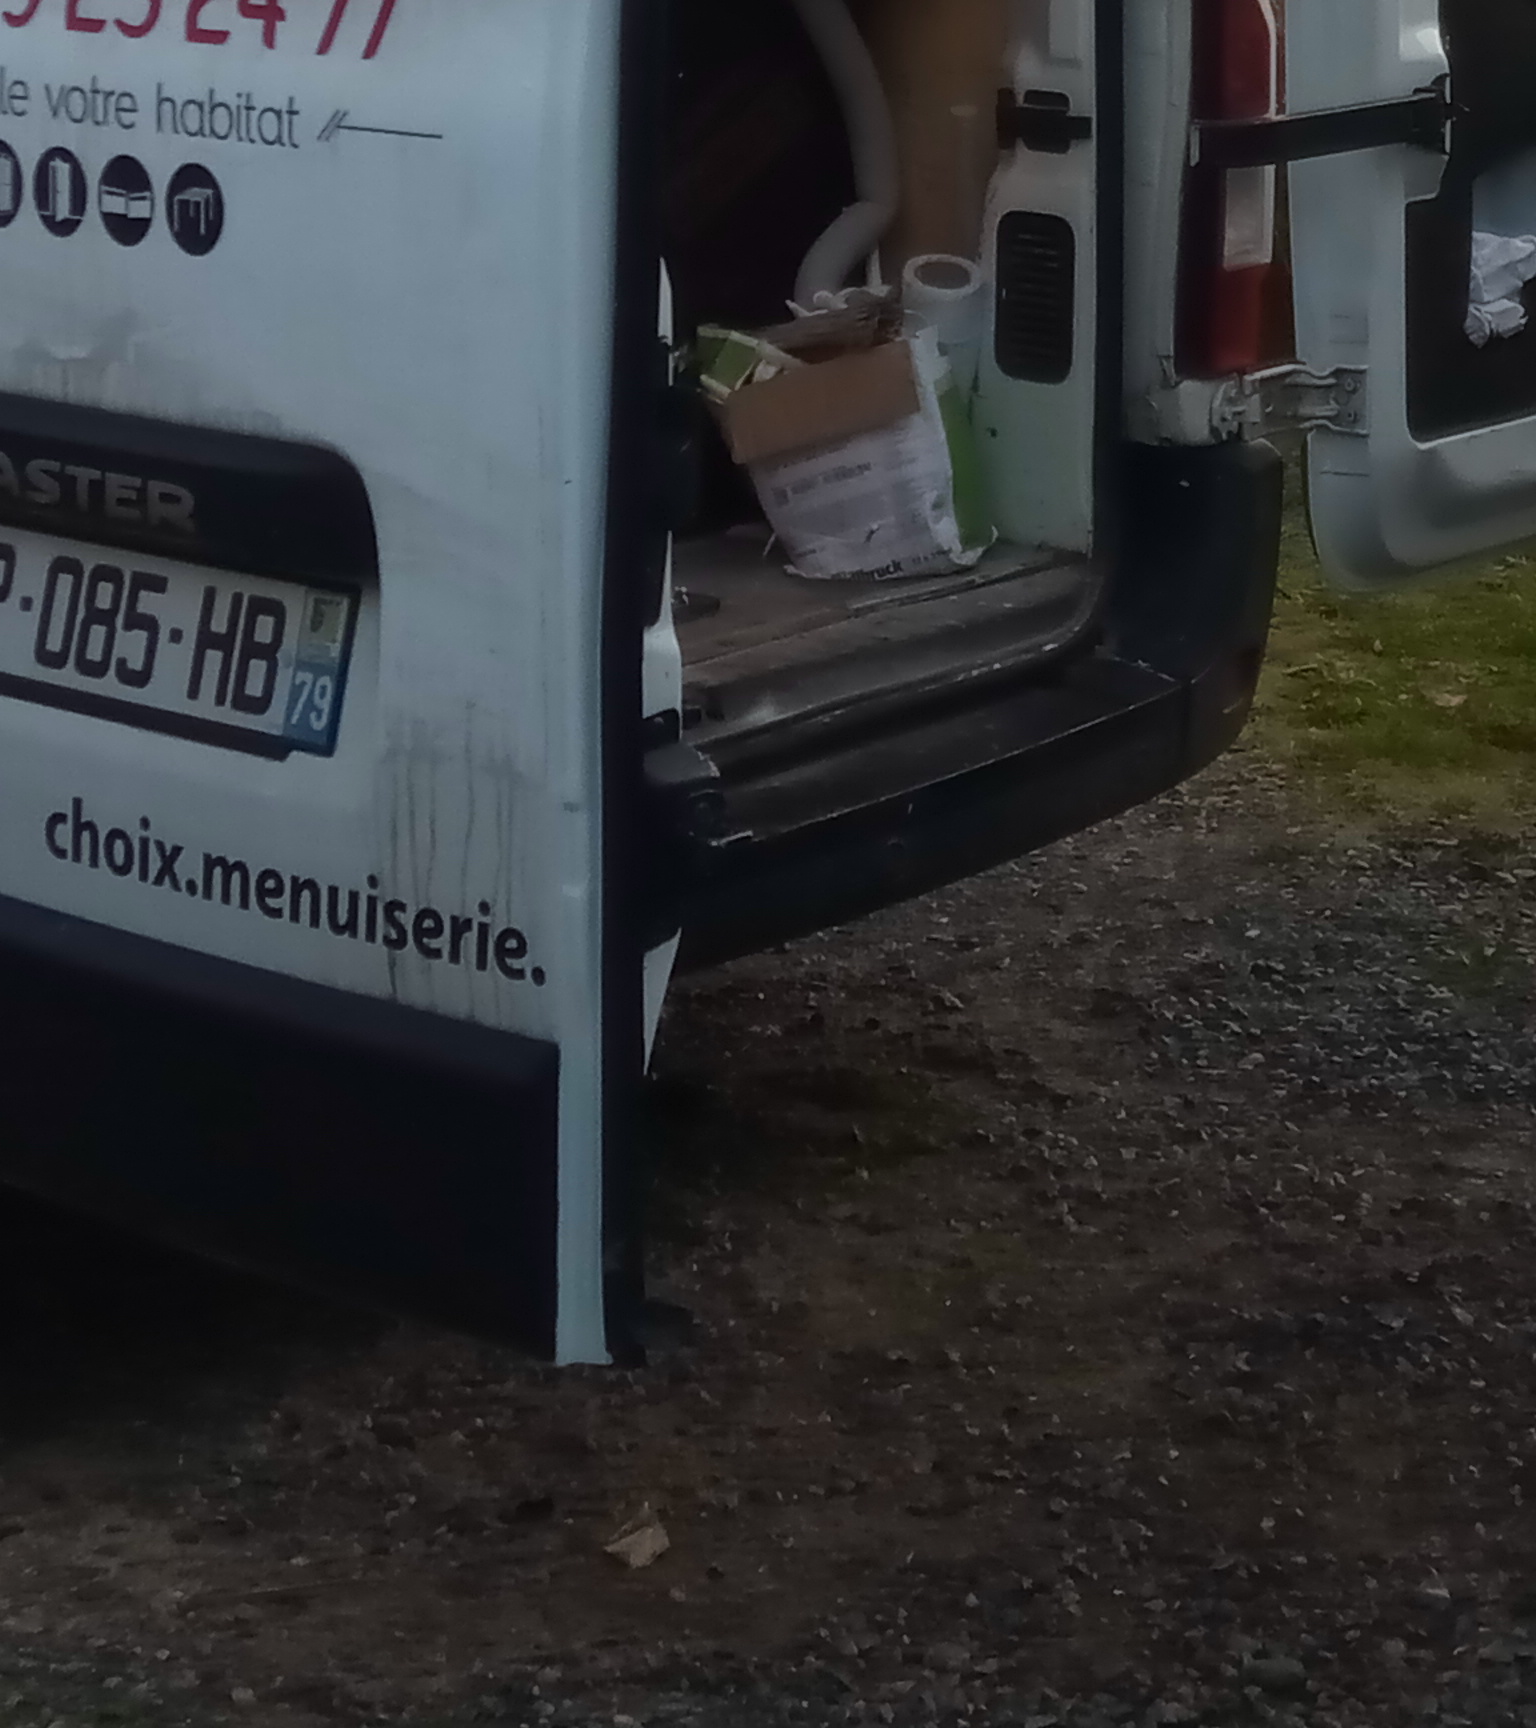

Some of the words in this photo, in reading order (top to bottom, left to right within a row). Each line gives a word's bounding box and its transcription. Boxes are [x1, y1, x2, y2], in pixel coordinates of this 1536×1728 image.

[44, 75, 139, 132] votre
[155, 82, 301, 149] habitat
[292, 671, 332, 731] 79
[44, 796, 547, 987] choix.menuiserie.
